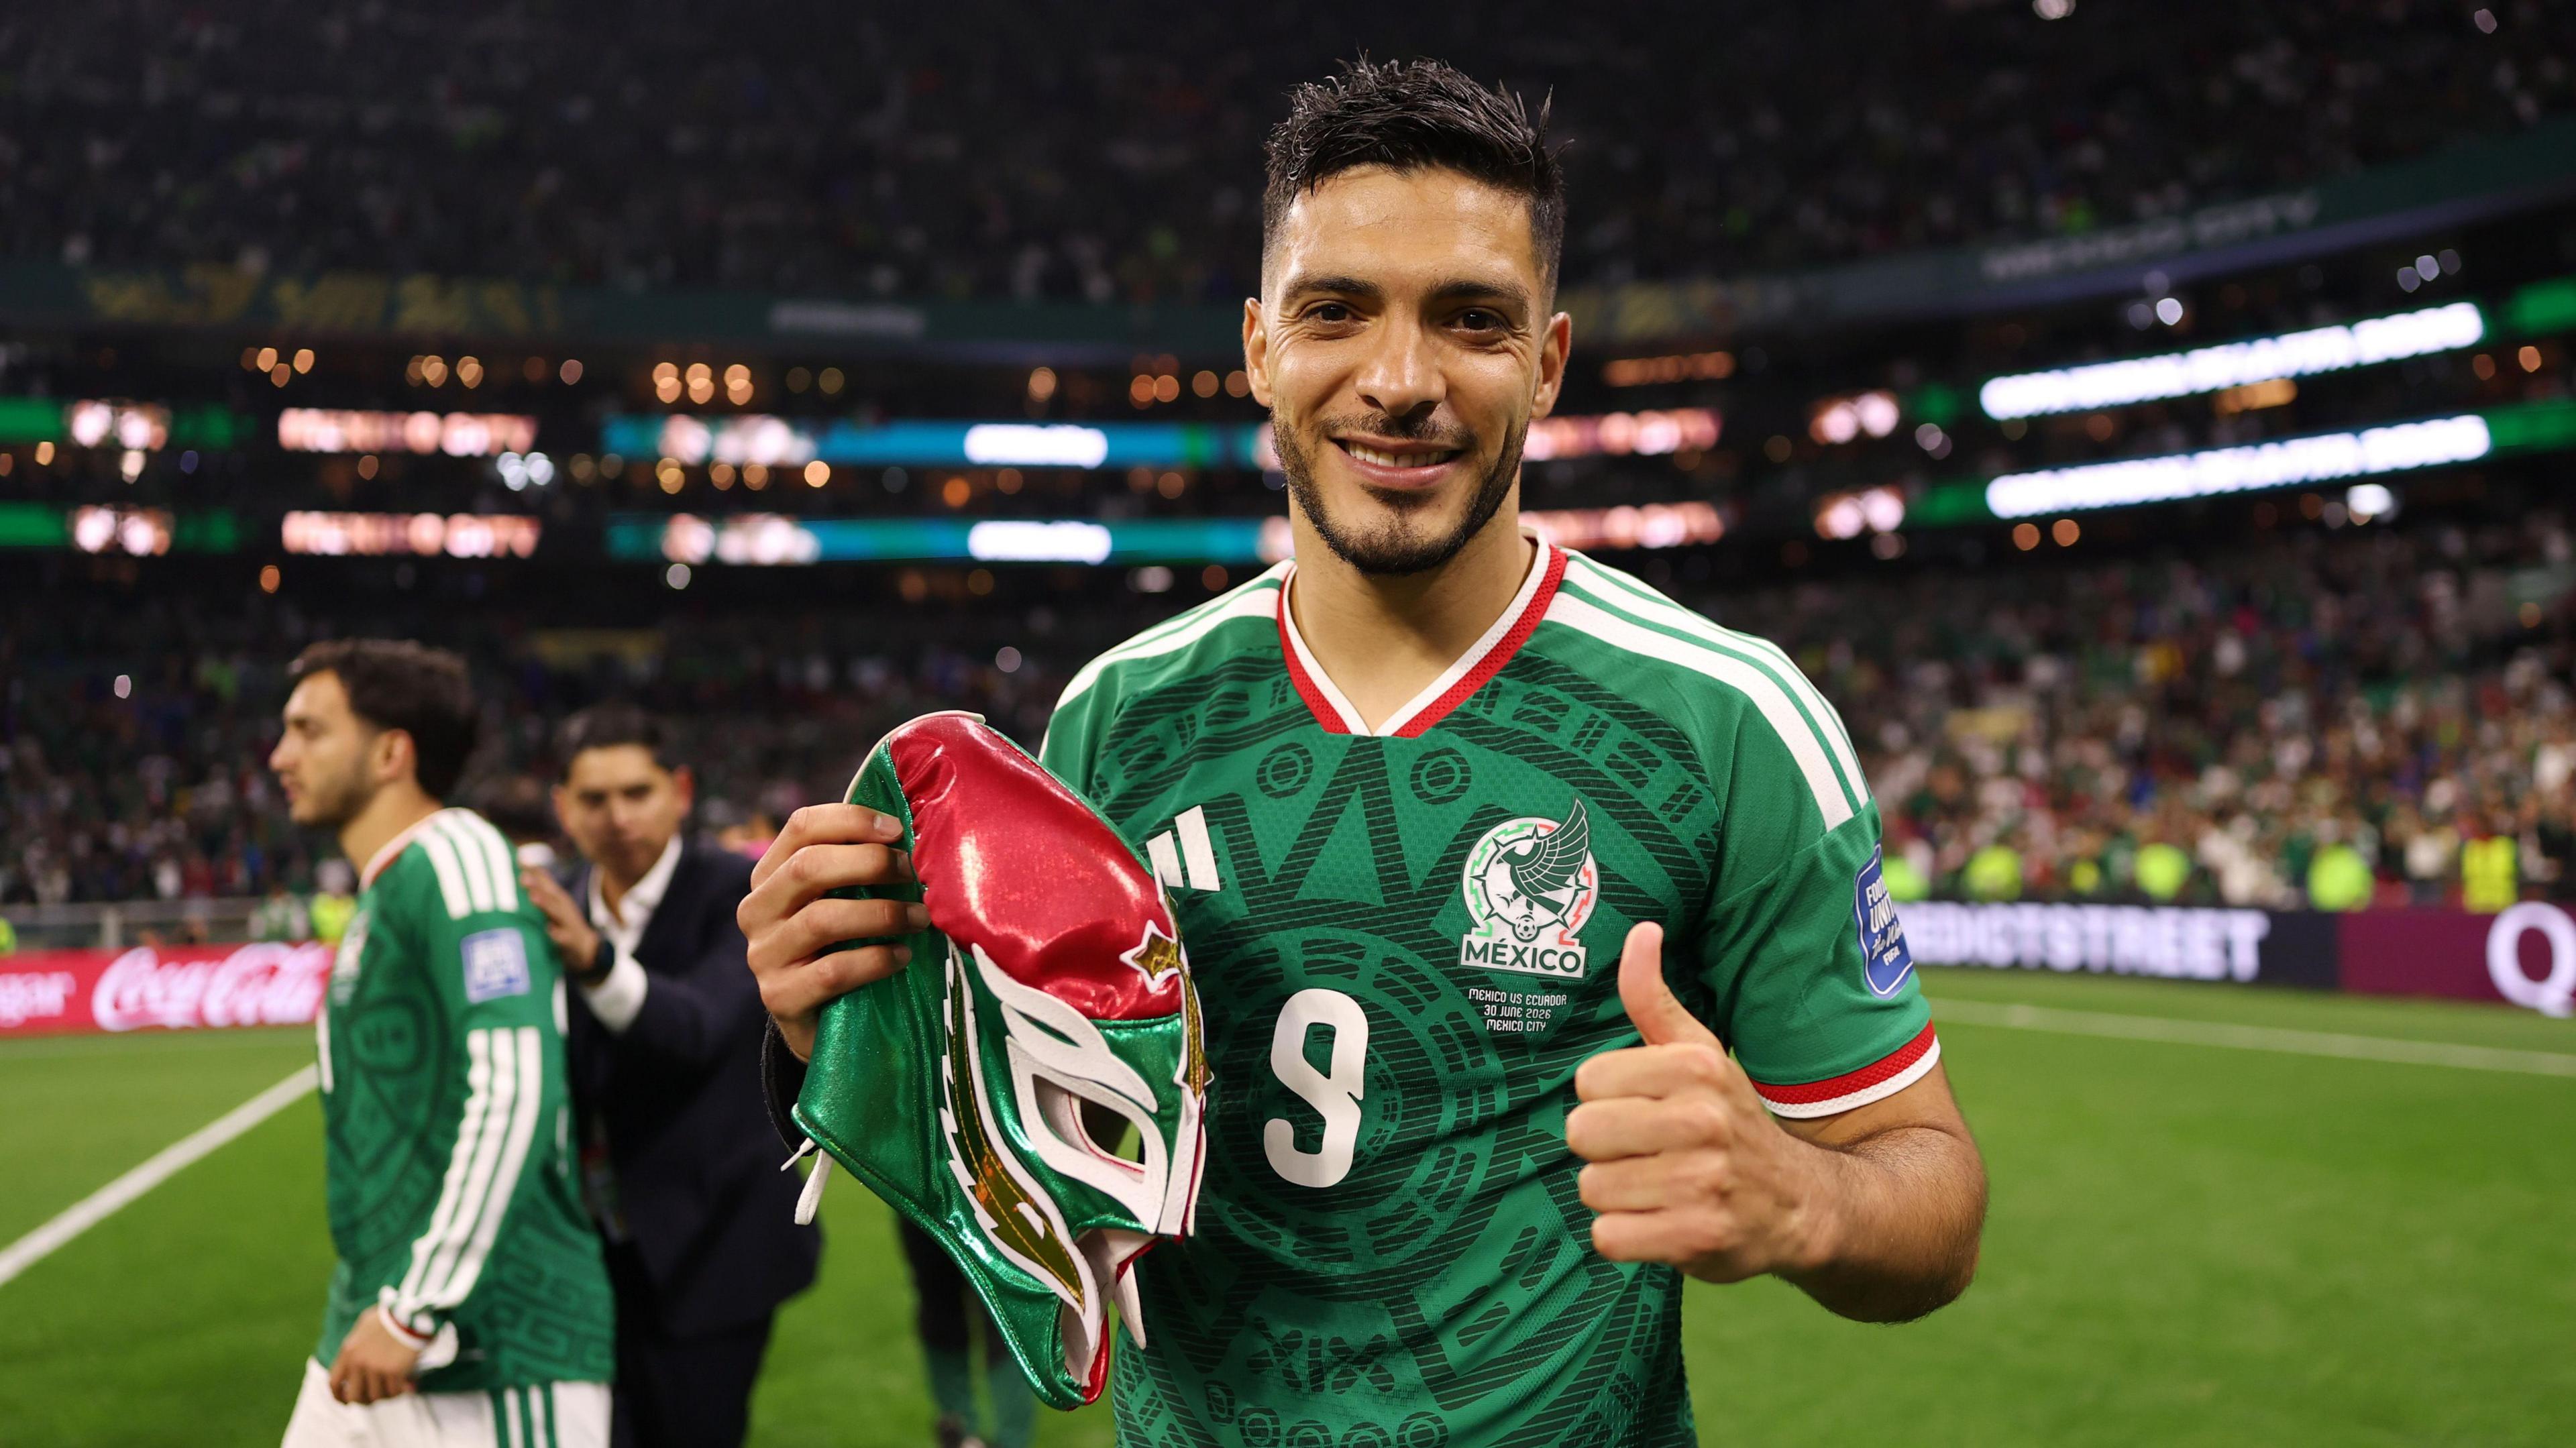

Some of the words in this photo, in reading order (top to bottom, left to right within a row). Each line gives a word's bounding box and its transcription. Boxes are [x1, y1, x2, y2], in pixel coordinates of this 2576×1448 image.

[1866, 874, 1887, 906] FOOT
[1870, 891, 1895, 933] UNIT
[1465, 938, 1580, 973] MÉXICO
[1883, 946, 1900, 966] FIFA
[1896, 901, 2270, 983] EDICTSTREET
[1468, 989, 1507, 1003] MEXICO
[1525, 995, 1567, 1006] ECUADOR
[1484, 1005, 1497, 1016] 30
[1500, 1006, 1523, 1017] JUNE
[1525, 1008, 1551, 1019] 2026
[1487, 1019, 1523, 1032] MEXICO
[1526, 1021, 1546, 1032] CITY
[1264, 988, 1368, 1188] 9
